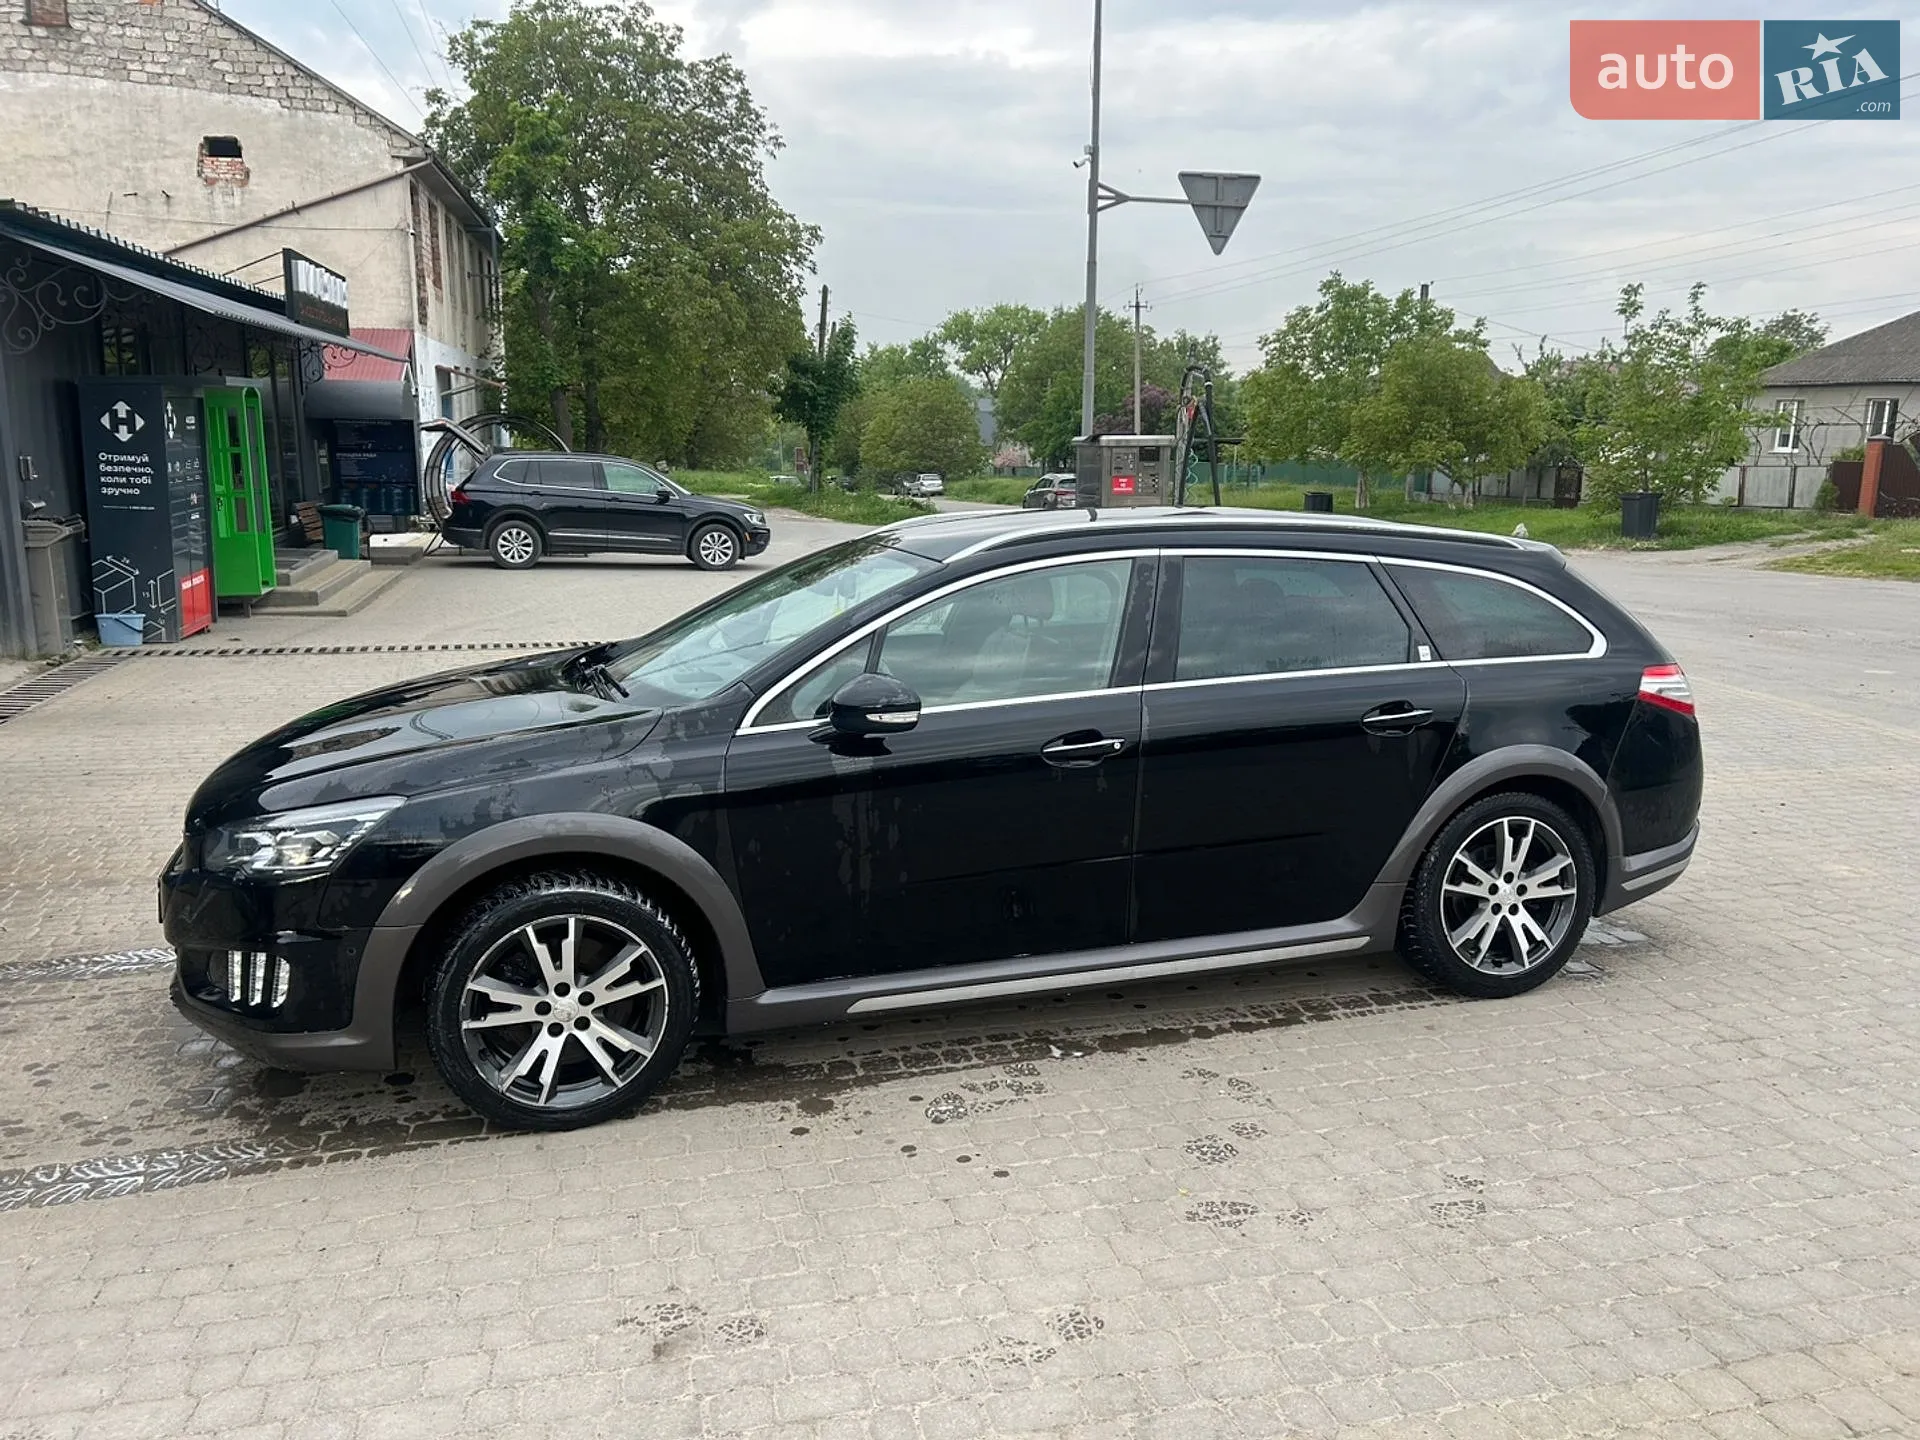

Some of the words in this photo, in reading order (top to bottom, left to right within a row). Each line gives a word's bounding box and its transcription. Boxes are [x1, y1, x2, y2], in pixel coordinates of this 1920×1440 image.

[98, 452, 149, 464] Отримуй
[99, 463, 154, 474] безпечно,
[100, 476, 127, 484] коли
[128, 476, 152, 485] тобі
[101, 487, 140, 495] зручно
